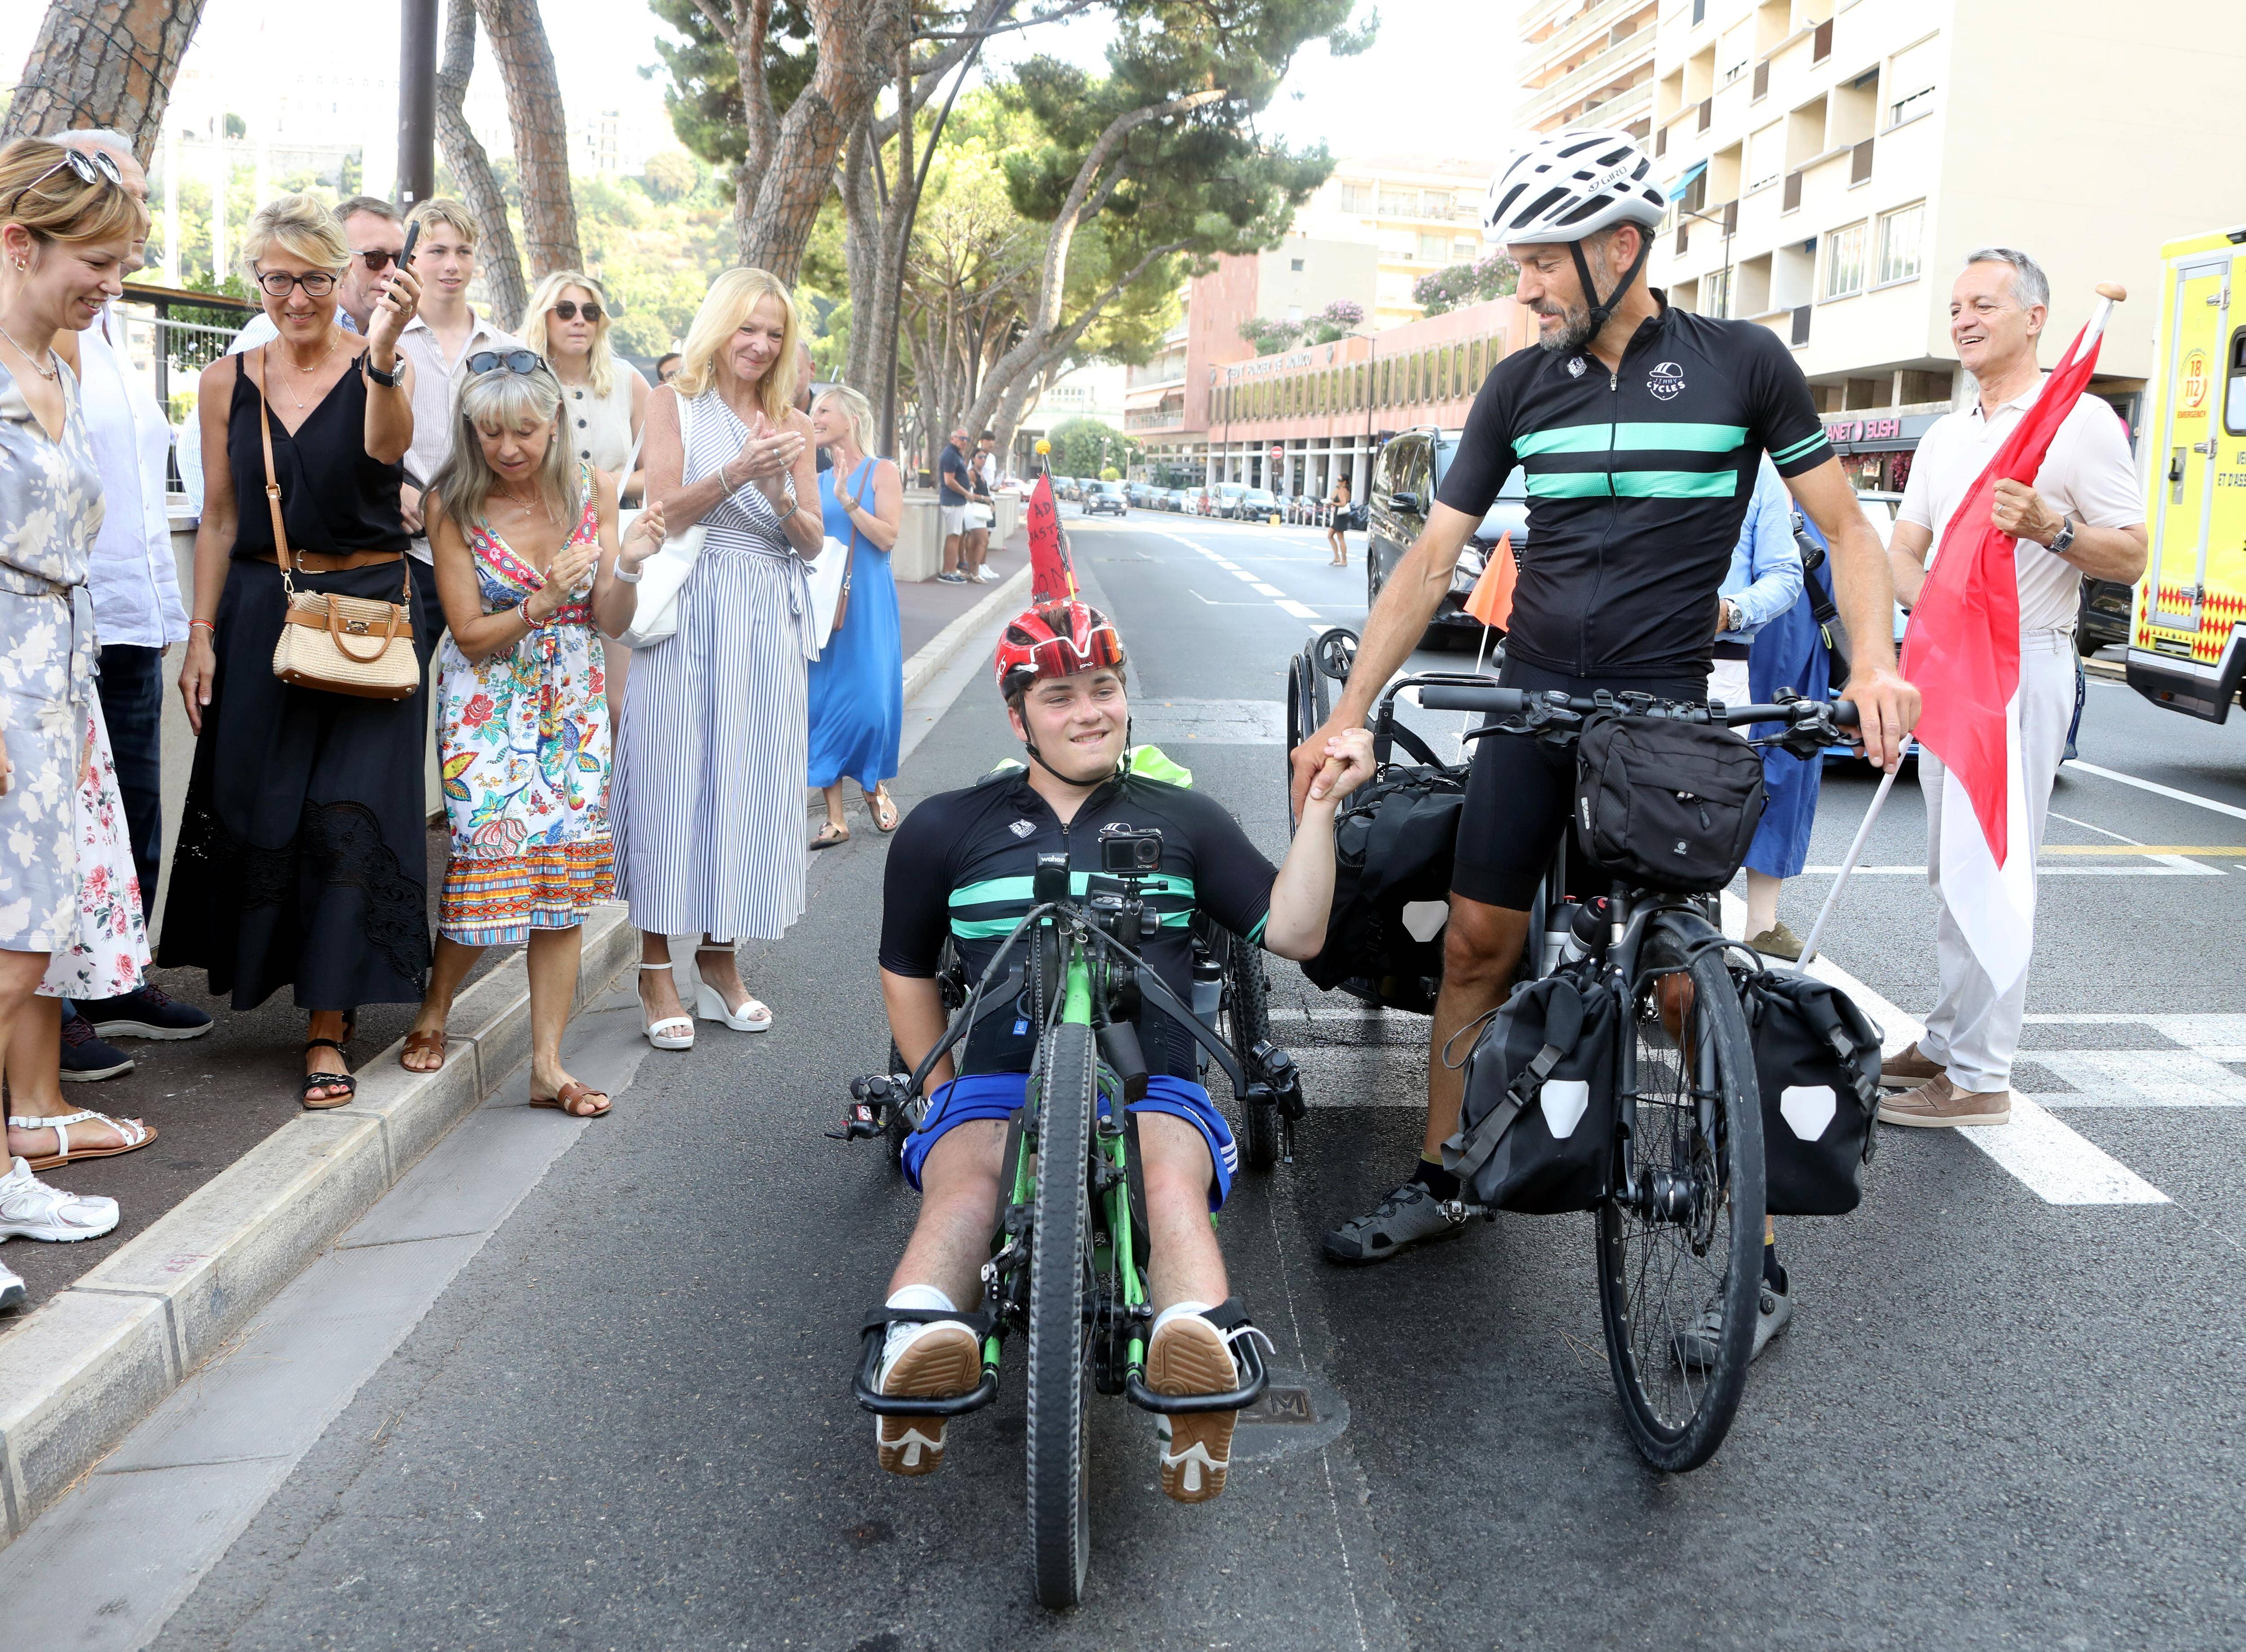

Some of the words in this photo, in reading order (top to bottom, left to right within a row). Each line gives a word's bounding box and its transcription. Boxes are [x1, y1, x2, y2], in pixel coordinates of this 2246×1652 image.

[1601, 167, 1627, 185] GIRO
[1286, 351, 1312, 369] MONACO
[2191, 360, 2202, 377] 18
[1646, 381, 1685, 393] CYCLES
[2185, 380, 2200, 397] 112
[1822, 422, 1854, 441] ANET
[1866, 419, 1901, 438] SUSHI
[1035, 502, 1051, 519] AD
[1041, 855, 1066, 863] wahoo
